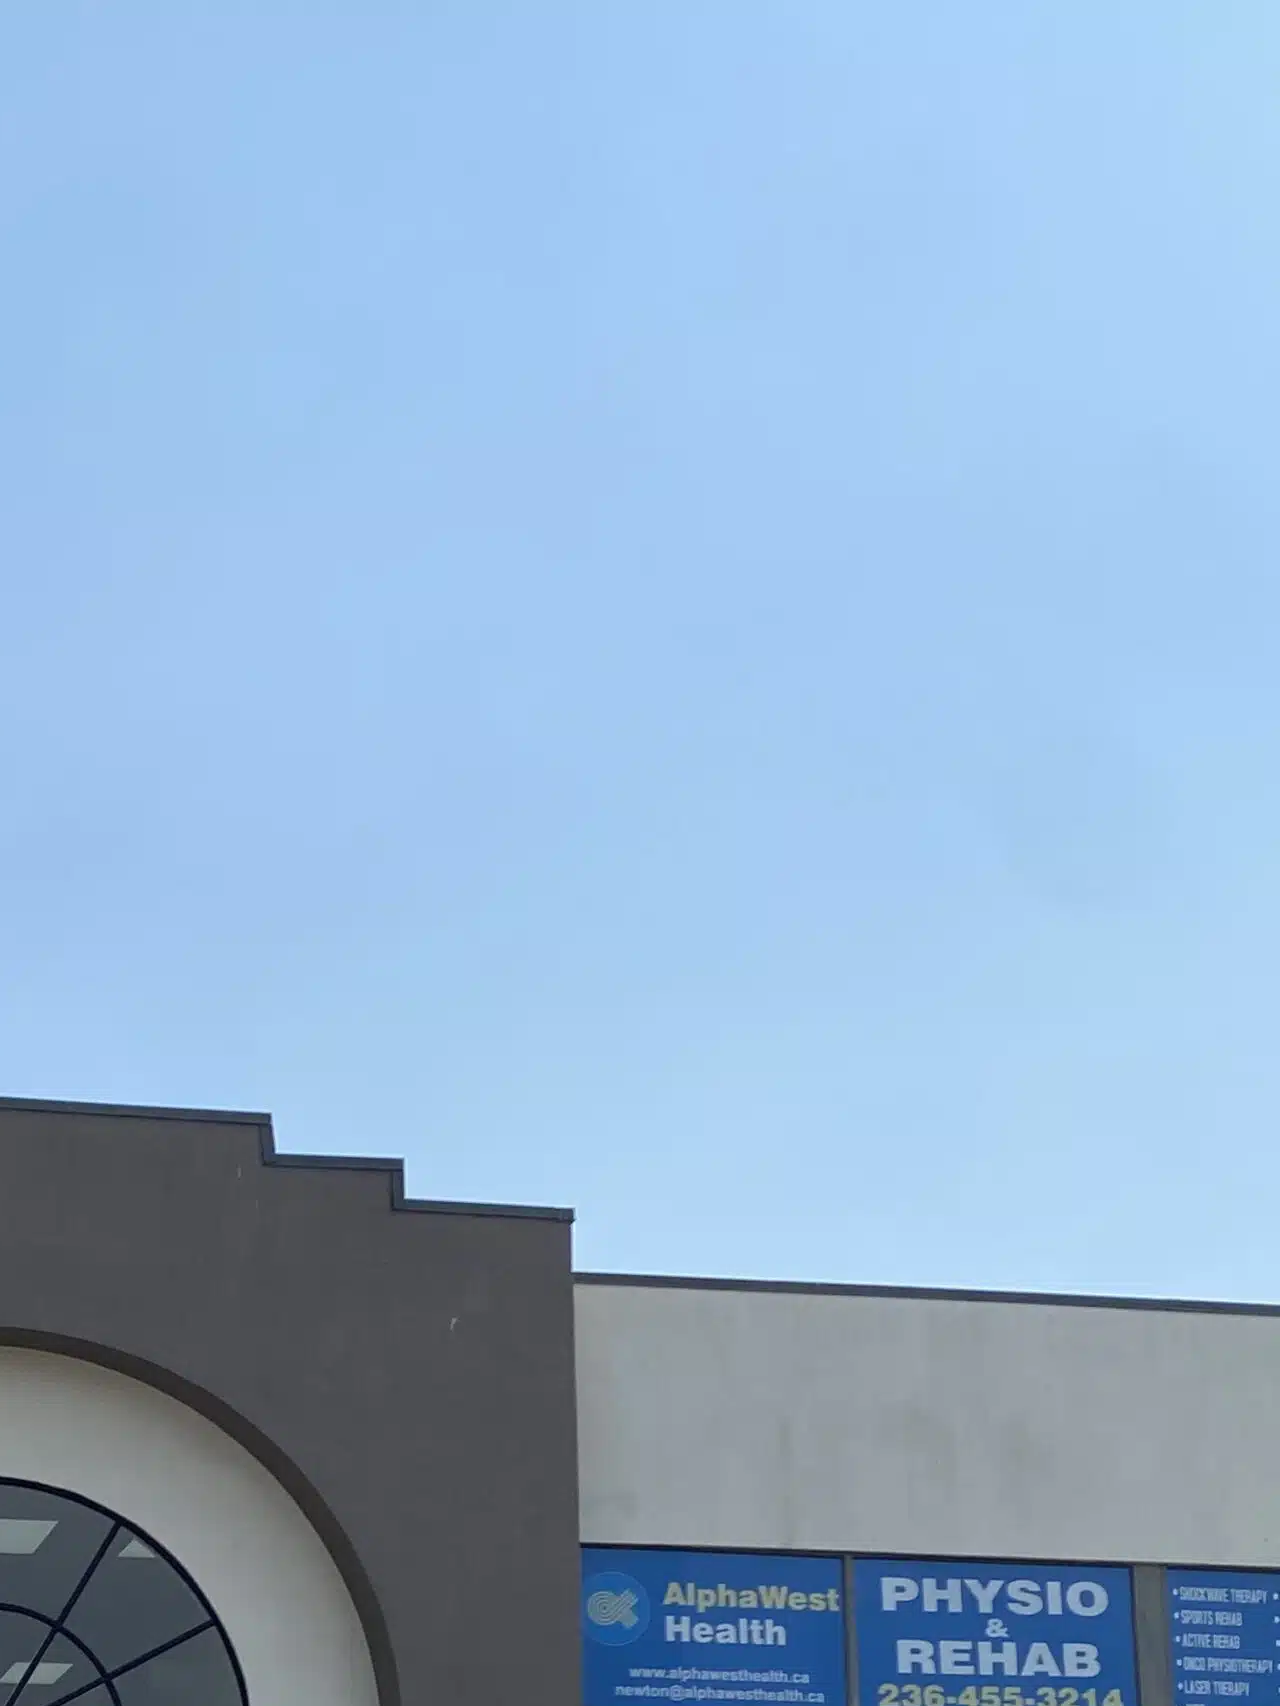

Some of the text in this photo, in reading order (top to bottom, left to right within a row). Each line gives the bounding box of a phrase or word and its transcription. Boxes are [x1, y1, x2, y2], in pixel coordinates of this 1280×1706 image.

[663, 1581, 840, 1613] AlphaWest
[880, 1576, 1109, 1617] PHYSIO
[664, 1615, 787, 1647] Health
[984, 1618, 1010, 1638] &
[896, 1639, 1101, 1678] REHAB
[628, 1666, 810, 1684] www.alphawesthealth.ca
[615, 1684, 825, 1703] newton@alphawesthealth.ca
